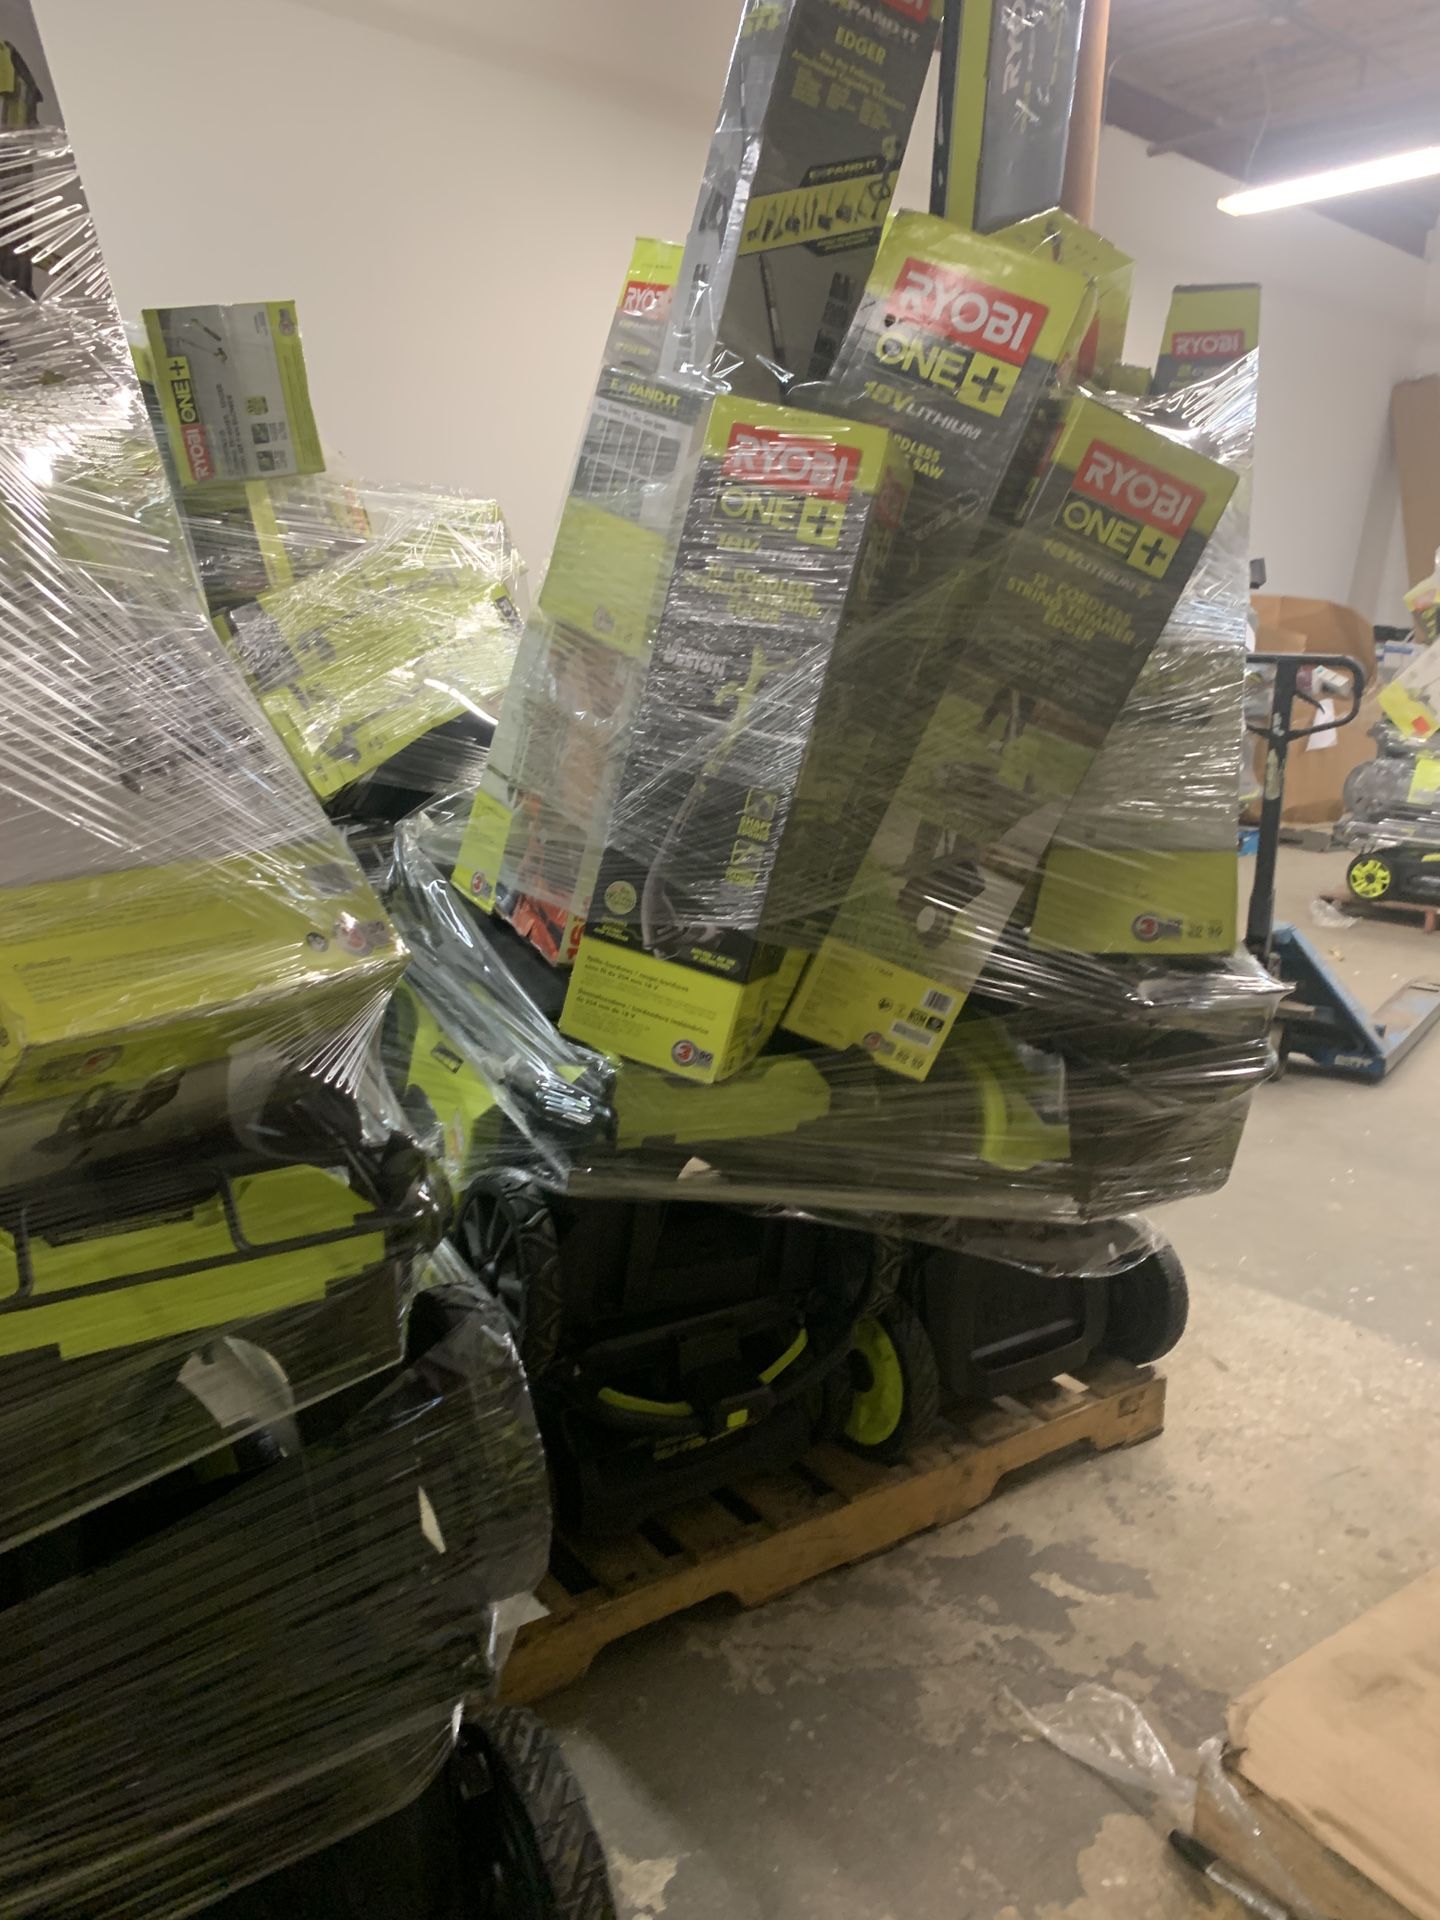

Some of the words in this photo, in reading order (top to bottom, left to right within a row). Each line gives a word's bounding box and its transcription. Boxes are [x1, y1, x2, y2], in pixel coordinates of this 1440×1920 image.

[809, 159, 878, 180] EPAND-IT
[899, 271, 1033, 351] RYOBI
[875, 331, 1014, 414] ONE+
[1174, 335, 1240, 355] RYOBI
[168, 359, 197, 424] ONE+
[608, 377, 680, 407] EPAND-IT
[905, 402, 982, 440] LITHIUM
[185, 427, 210, 480] RYOBI
[733, 434, 848, 490] RYOBI
[720, 484, 845, 545] ONE+
[1084, 450, 1193, 526] RYOBI
[1062, 501, 1174, 574] ONE+
